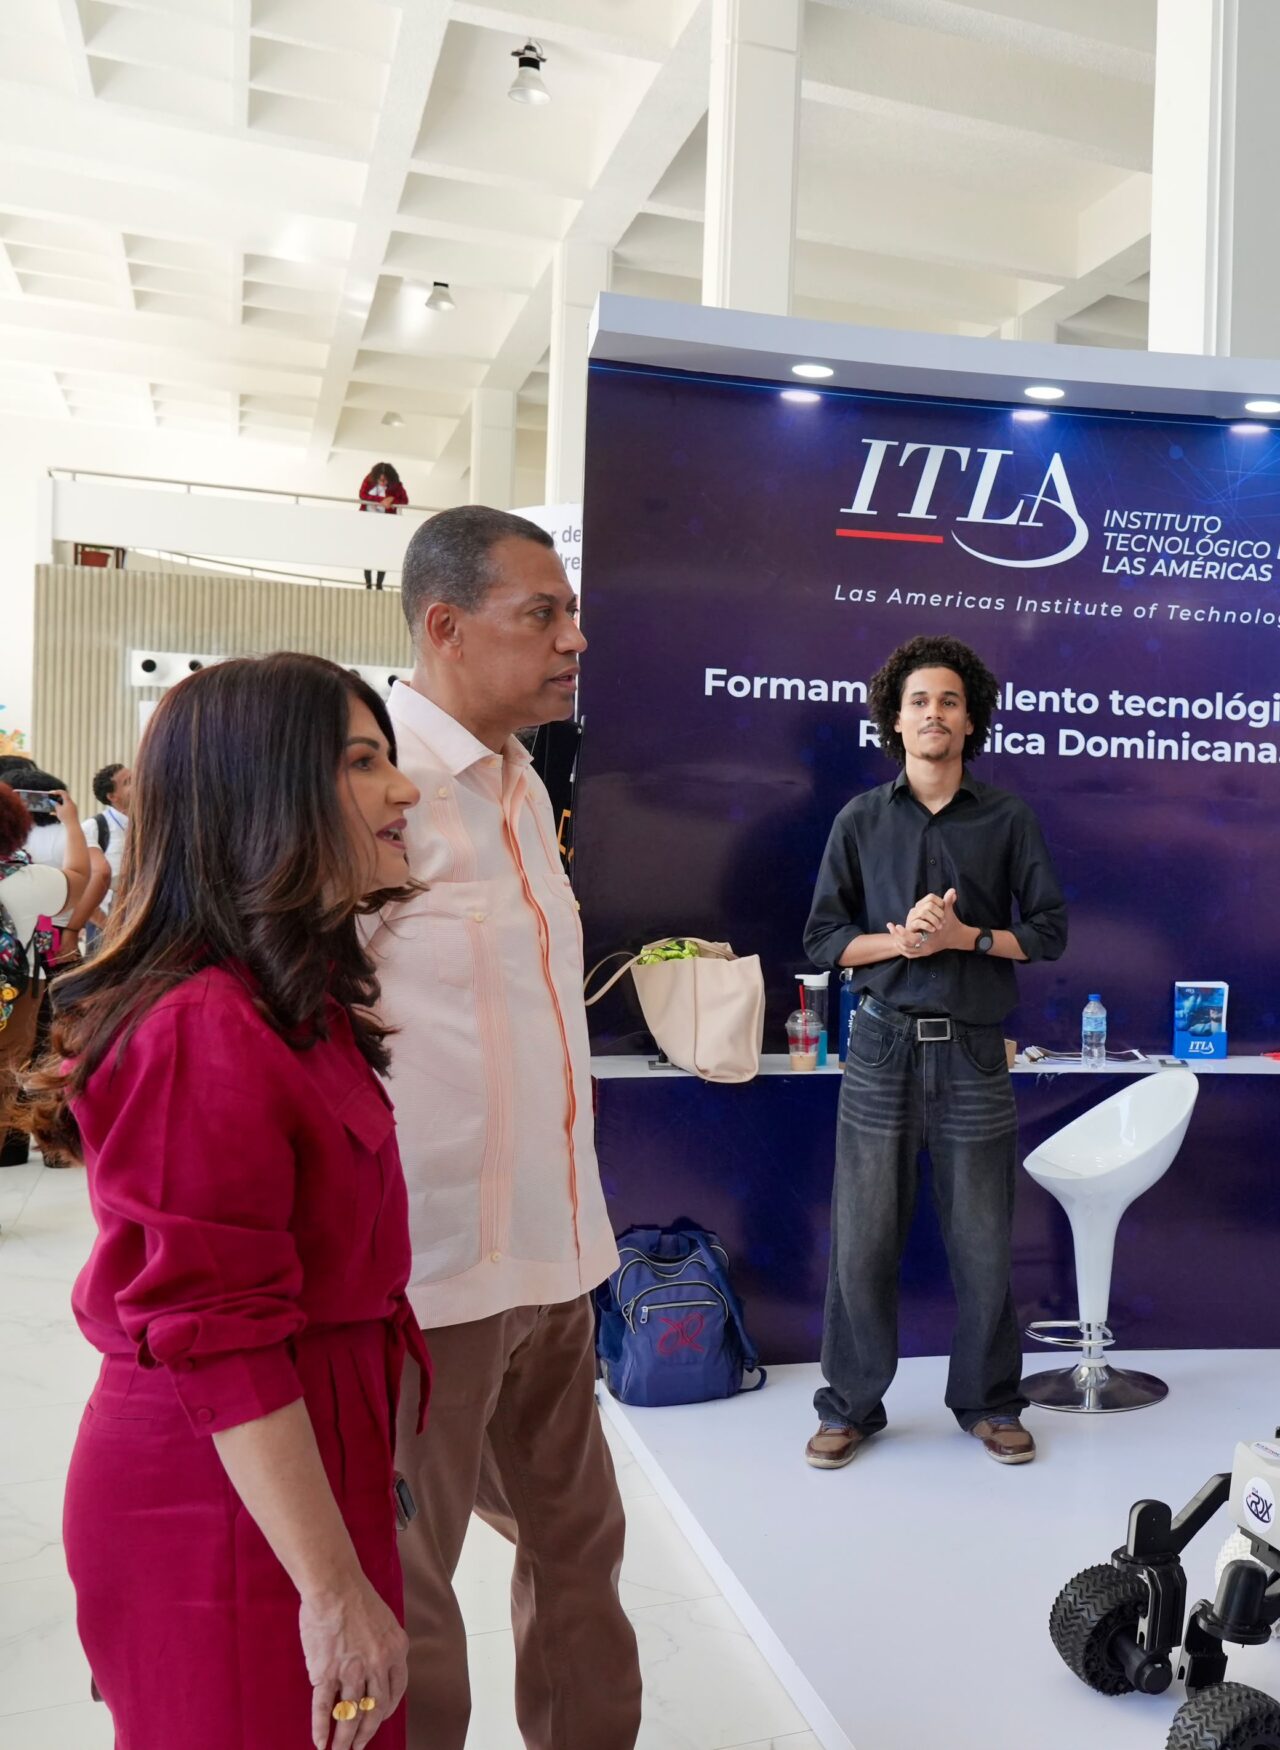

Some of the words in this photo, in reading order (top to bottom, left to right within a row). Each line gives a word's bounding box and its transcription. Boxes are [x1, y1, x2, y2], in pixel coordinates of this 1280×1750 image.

[838, 438, 1090, 569] ITLA
[1103, 509, 1222, 535] INSTITUTO
[1103, 532, 1272, 560] TECNOLÓGICO
[1101, 555, 1147, 576] LAS
[1149, 556, 1274, 582] AMÉRICAS
[834, 584, 877, 603] Las
[886, 588, 1006, 611] Americas
[1015, 596, 1124, 618] Institute
[1132, 603, 1159, 619] of
[704, 667, 869, 704] Formam
[1188, 1040, 1215, 1055] ITLA
